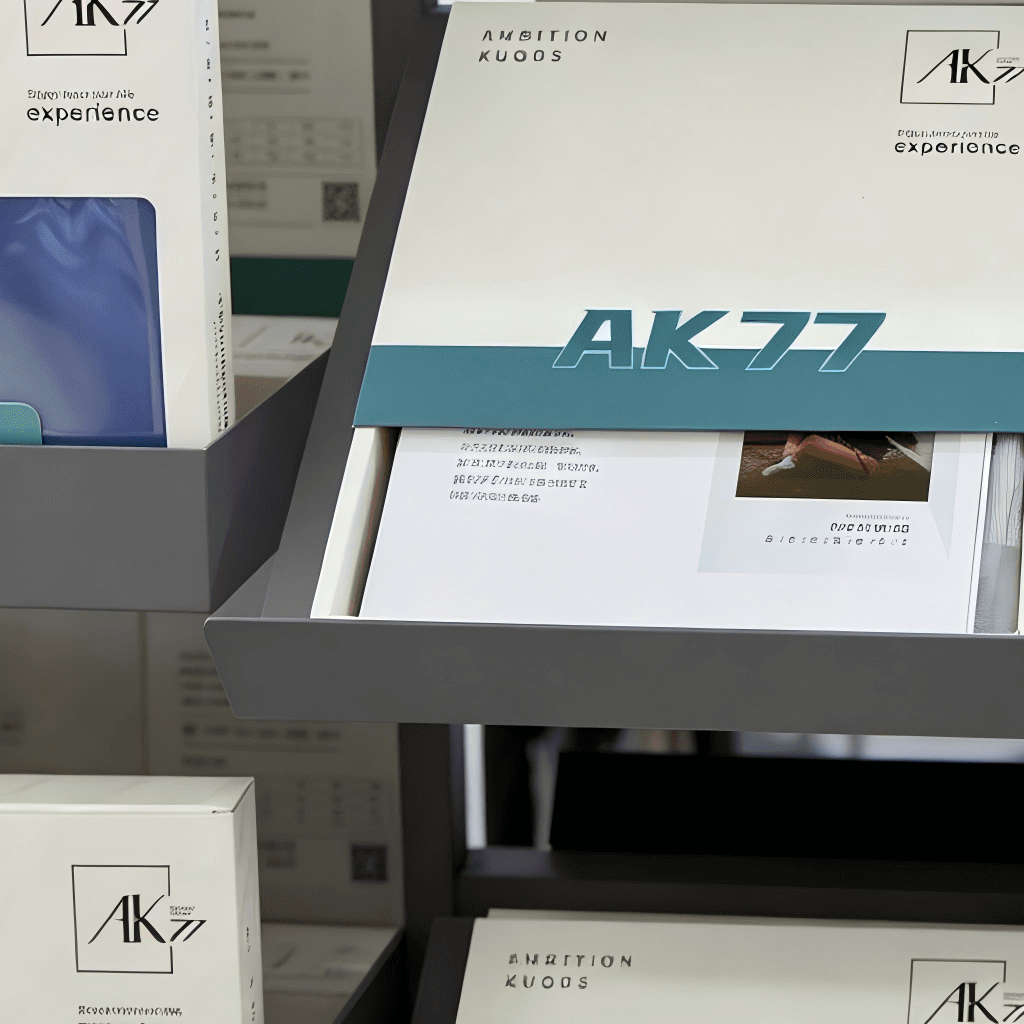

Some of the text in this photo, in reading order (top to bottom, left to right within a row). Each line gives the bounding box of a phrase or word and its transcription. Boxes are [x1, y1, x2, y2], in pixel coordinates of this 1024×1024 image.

[26, 102, 160, 127] experience
[894, 140, 1021, 157] experience
[552, 307, 887, 373] AK77
